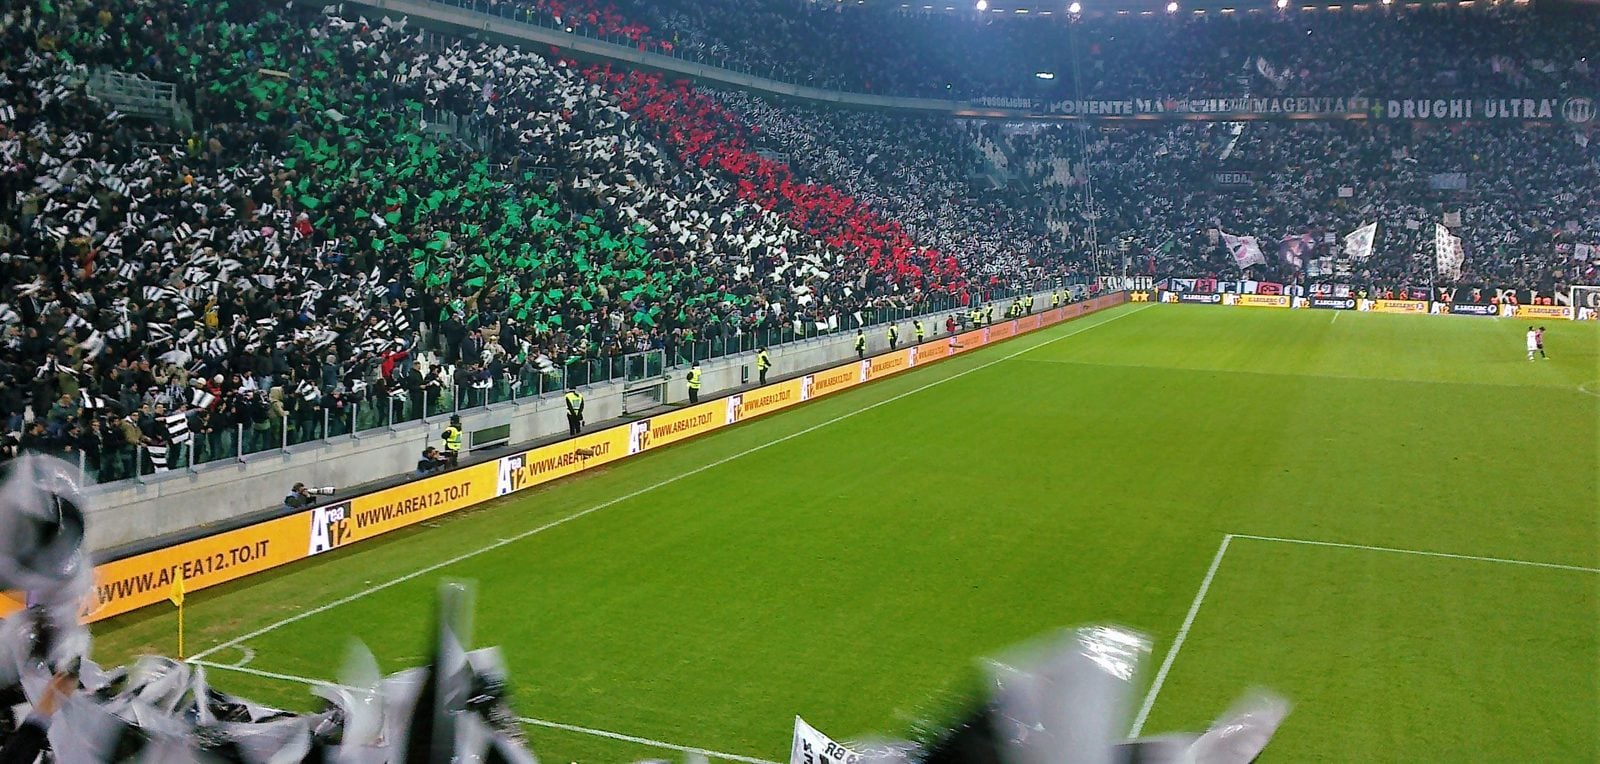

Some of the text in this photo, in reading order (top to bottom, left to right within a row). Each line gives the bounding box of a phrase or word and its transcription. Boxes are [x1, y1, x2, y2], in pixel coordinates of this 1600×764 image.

[1252, 97, 1345, 113] MAGENTA
[1387, 98, 1472, 119] DRUGHI
[652, 411, 713, 439] WWW.AREA12.TO.IT
[511, 466, 526, 491] 12
[356, 482, 471, 529] WWW.AREA12.TO.IT
[308, 504, 344, 556] Area
[329, 518, 351, 547] 12
